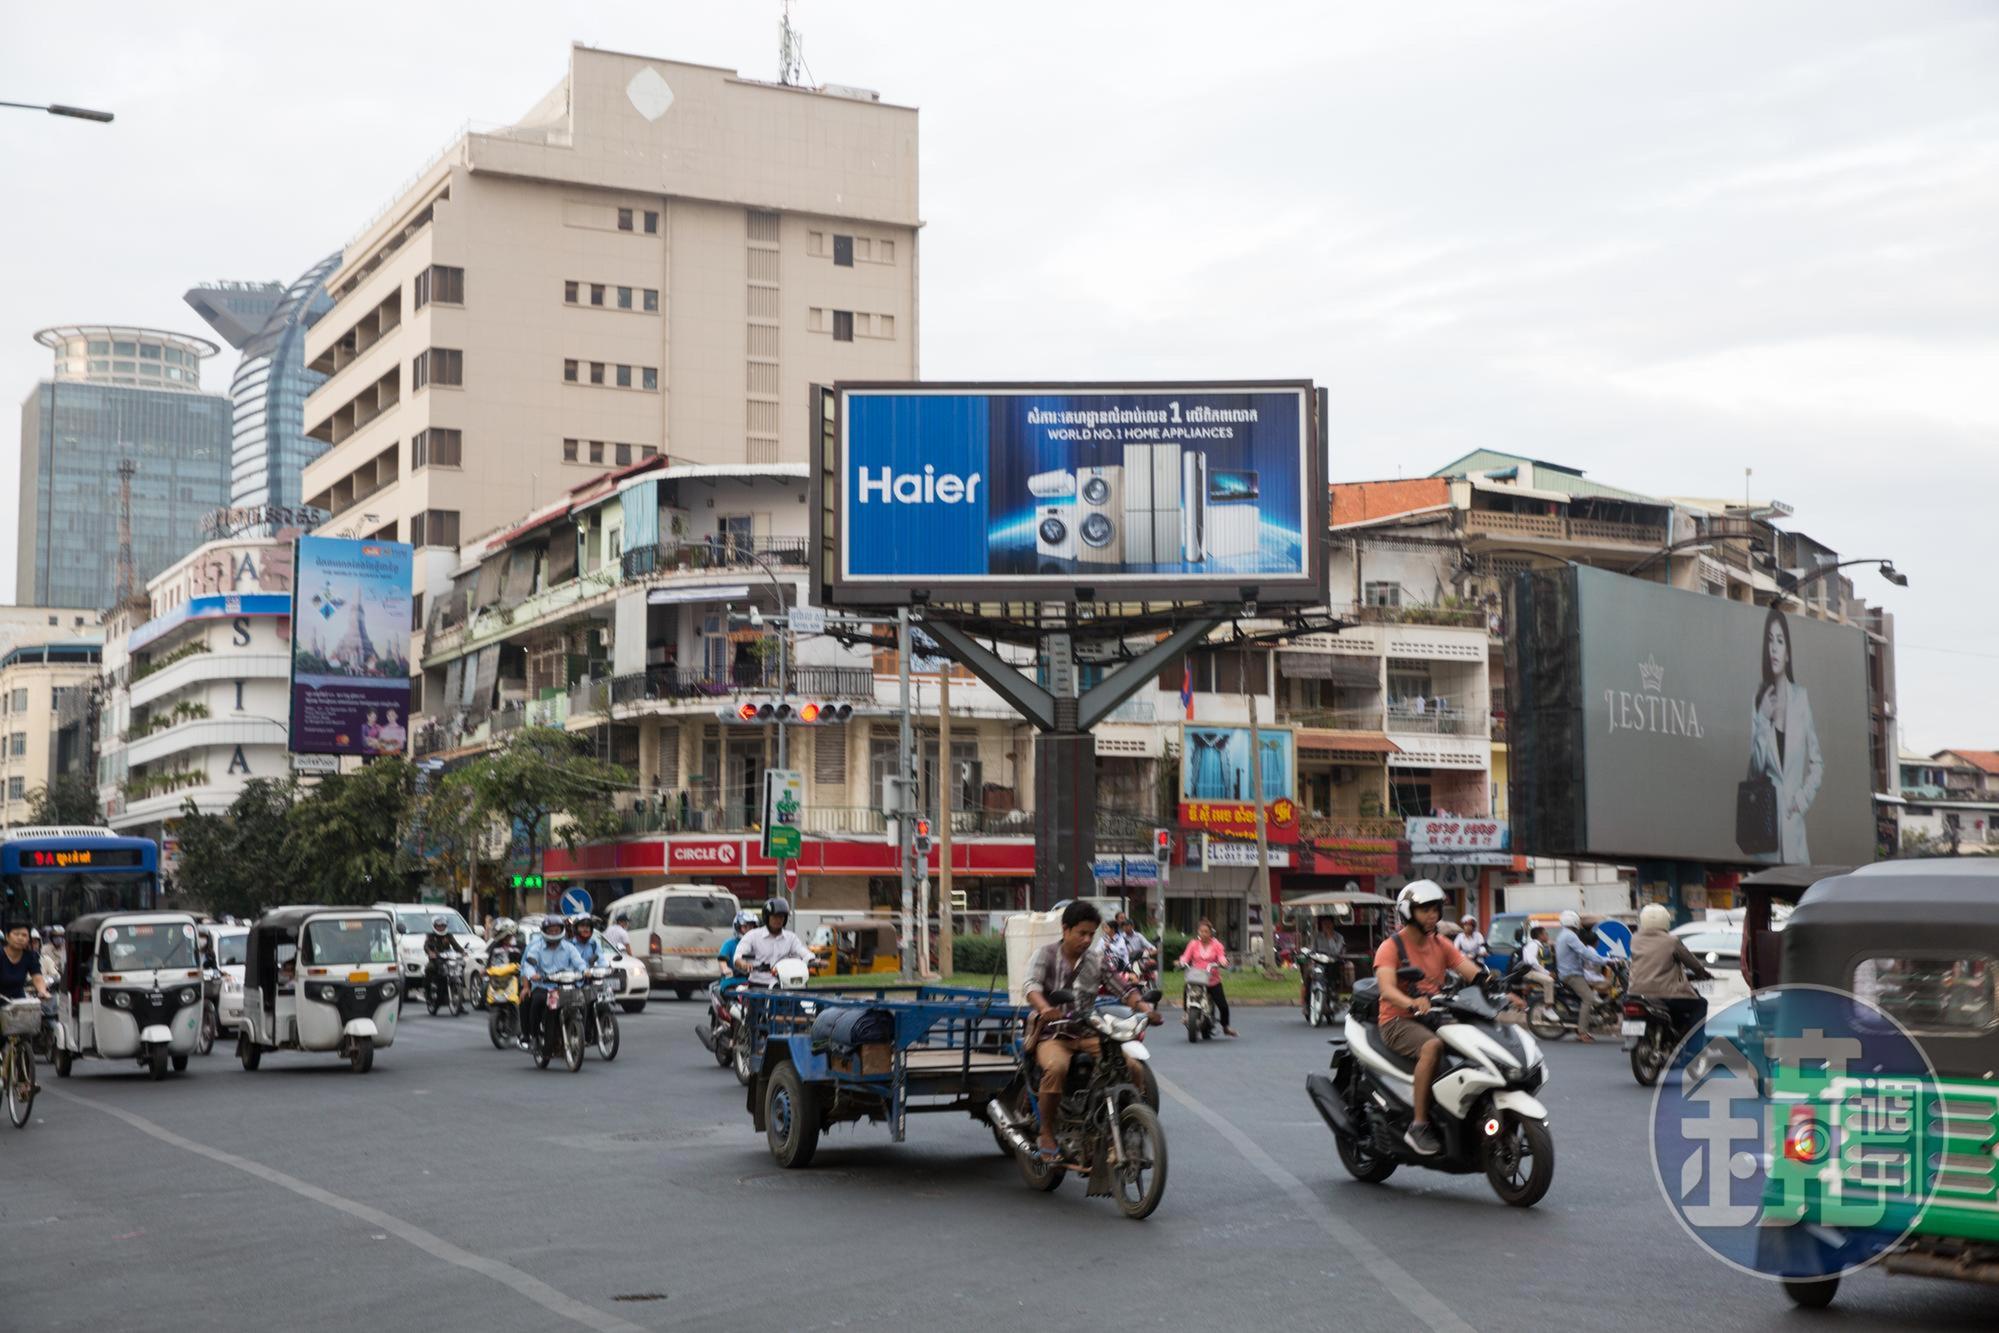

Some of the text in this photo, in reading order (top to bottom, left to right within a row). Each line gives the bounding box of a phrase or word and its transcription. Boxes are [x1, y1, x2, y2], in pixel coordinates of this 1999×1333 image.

[1168, 400, 1182, 423] 1
[1047, 428, 1091, 440] WORLD
[1124, 427, 1160, 440] HOME
[1161, 426, 1234, 439] APPLIANCES
[858, 464, 981, 504] Haier
[674, 847, 717, 861] CIRCLE
